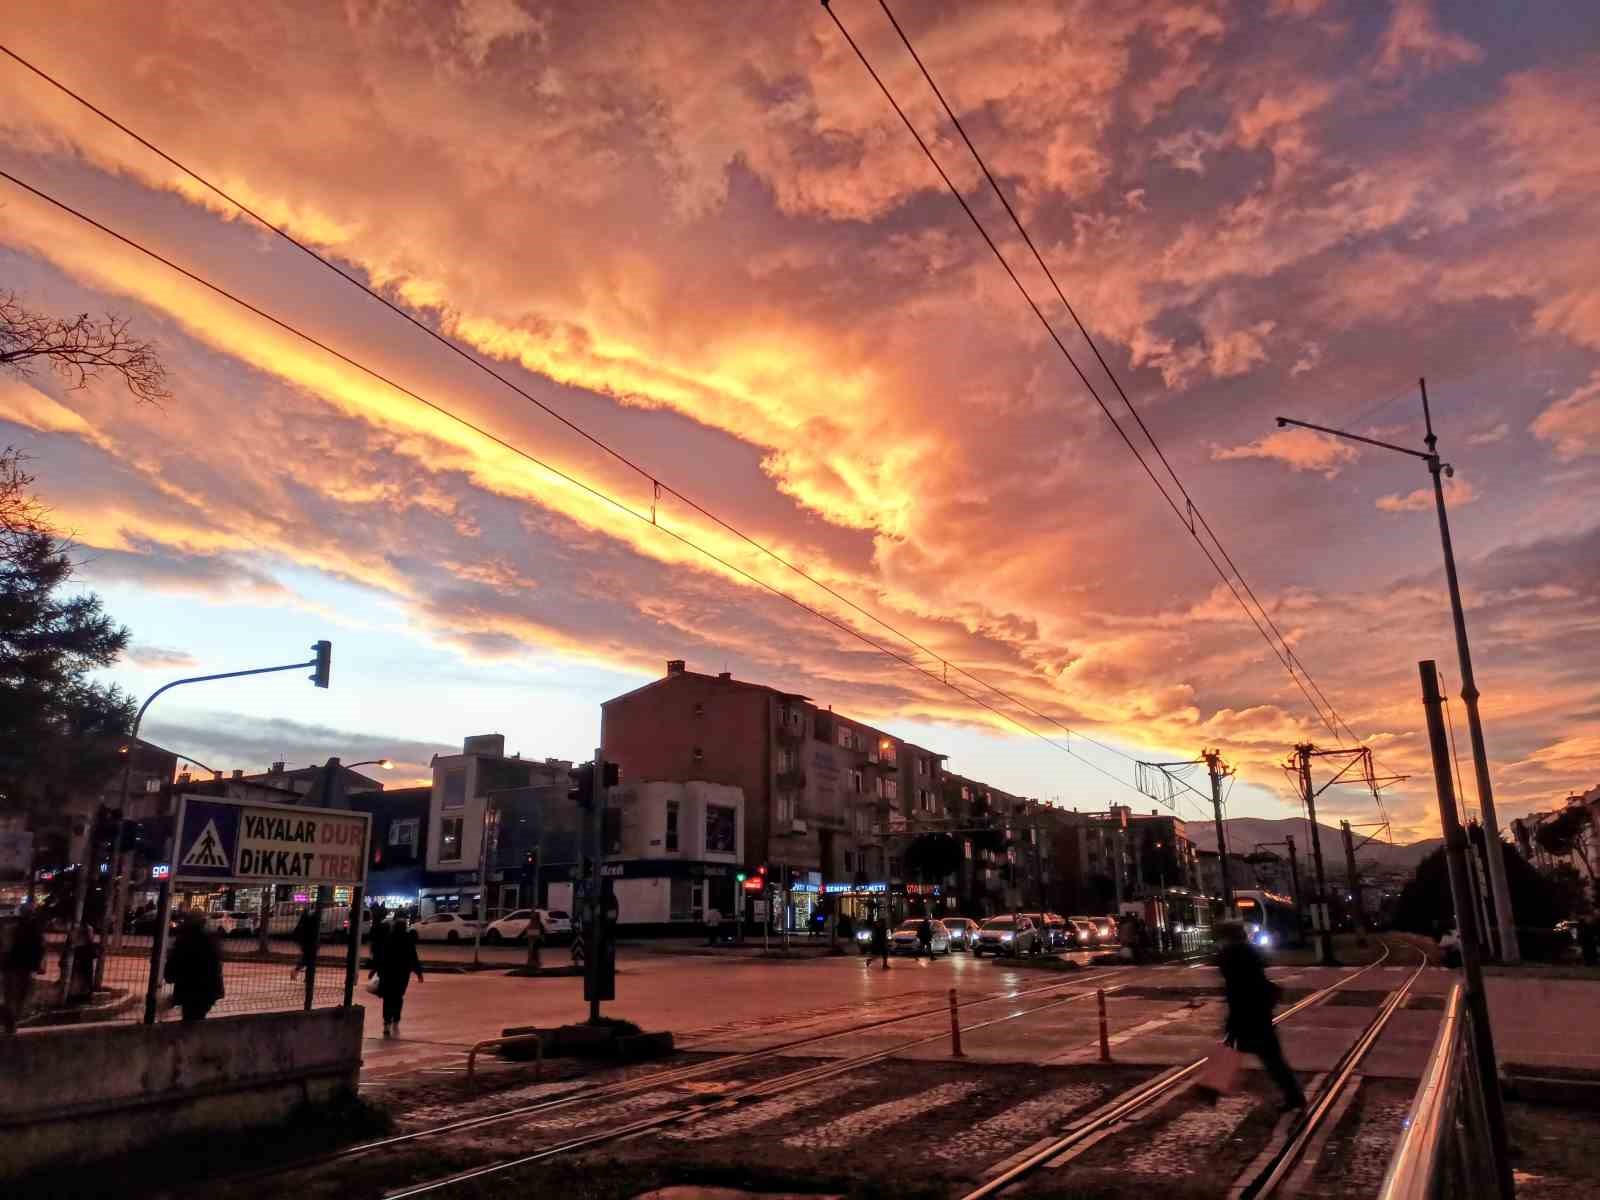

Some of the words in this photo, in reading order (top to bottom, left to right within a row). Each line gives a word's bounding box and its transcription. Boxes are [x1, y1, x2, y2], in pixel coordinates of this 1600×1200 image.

[245, 815, 316, 843] YAYALAR
[319, 823, 362, 847] DUR
[319, 853, 363, 878] TREN
